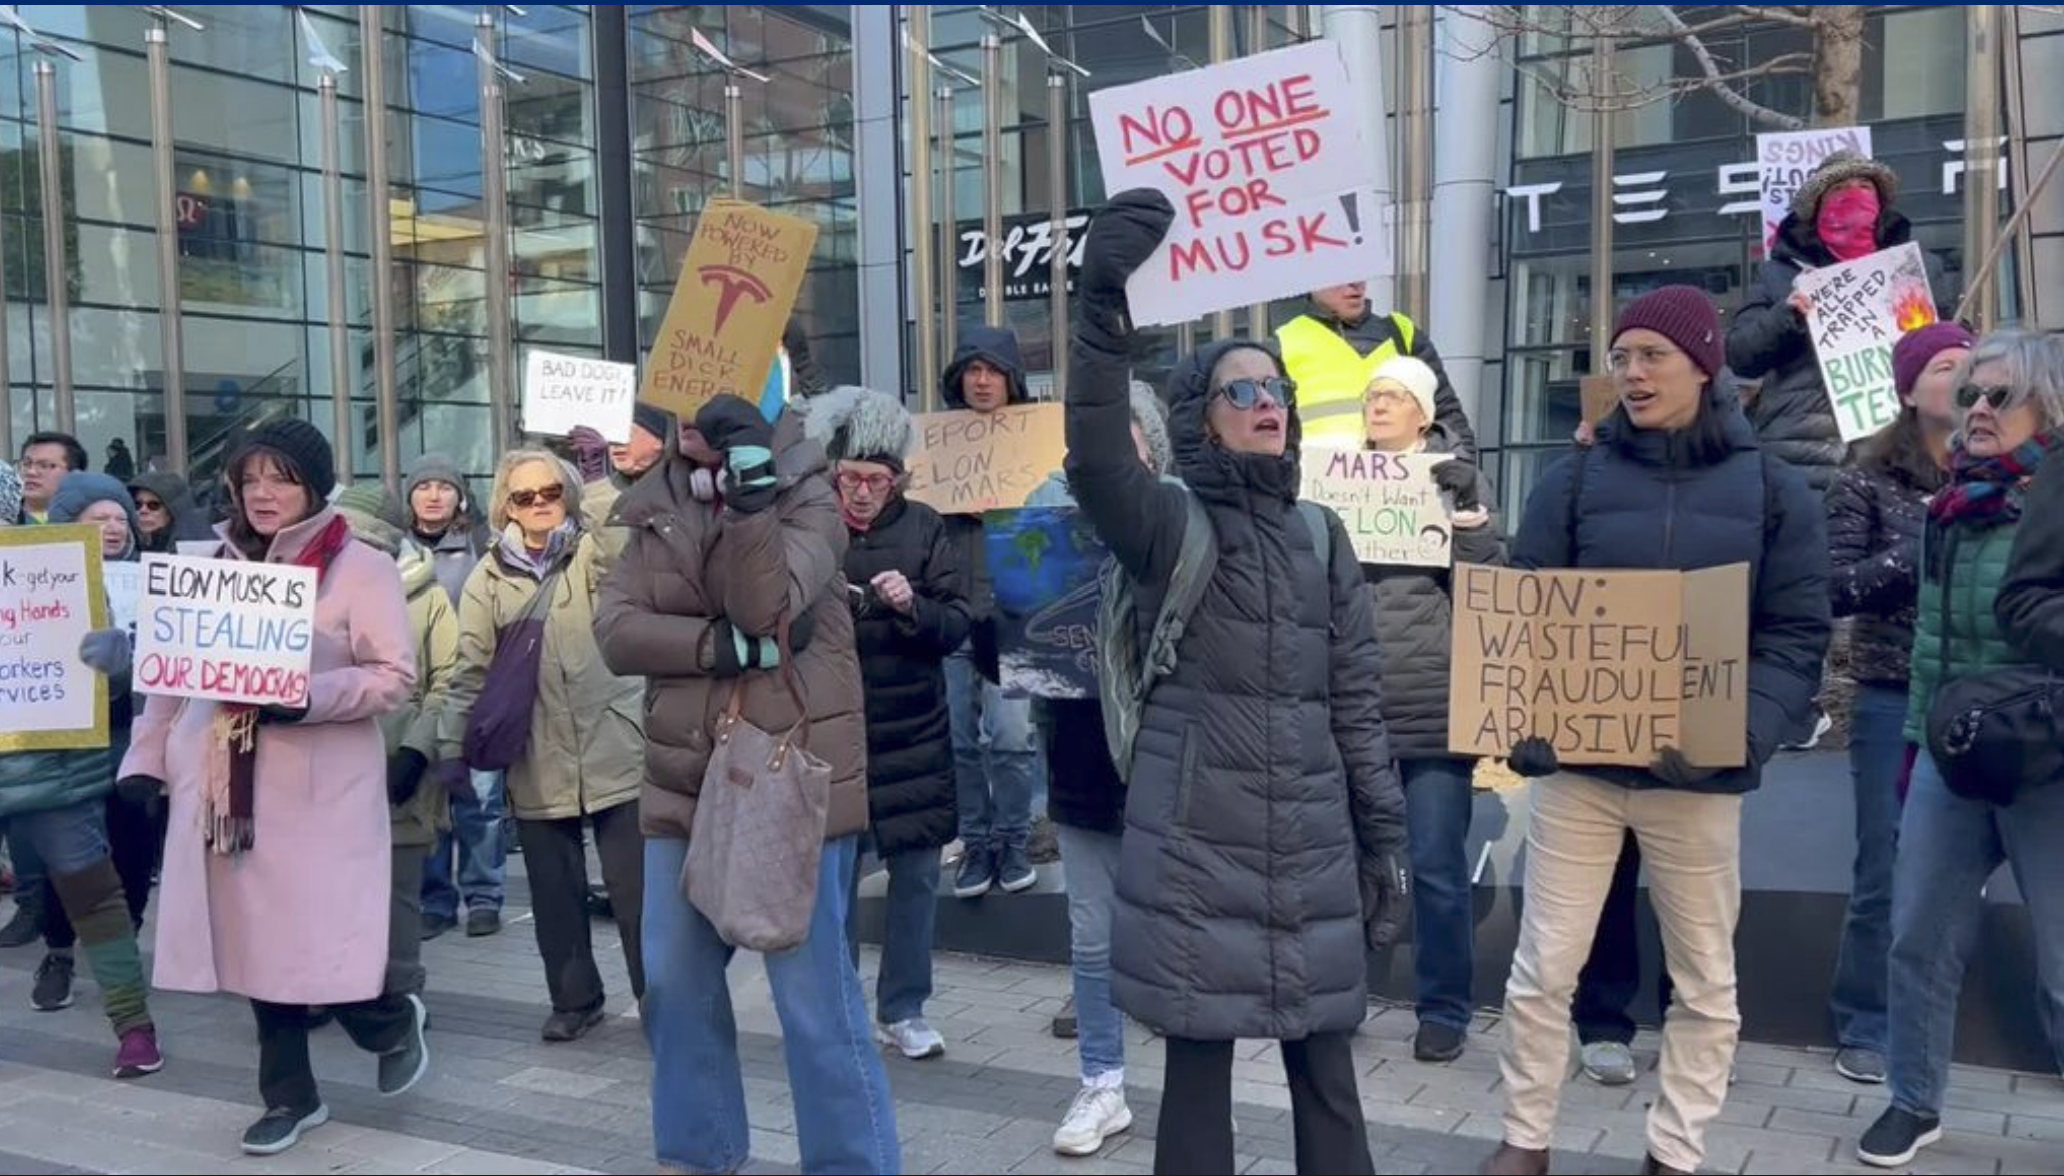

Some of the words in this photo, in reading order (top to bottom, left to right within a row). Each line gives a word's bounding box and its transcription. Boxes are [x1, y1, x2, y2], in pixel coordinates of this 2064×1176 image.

[1118, 106, 1193, 153] NO
[1214, 74, 1320, 128] ONE
[1163, 128, 1321, 186] VOTED
[1186, 178, 1287, 228] FOR
[701, 223, 789, 264] POWERED
[724, 212, 782, 241] NOW
[1169, 191, 1363, 281] MUSK!
[729, 250, 757, 267] BY
[979, 283, 1028, 298] DBLE
[1033, 280, 1074, 294] EAE
[1809, 268, 1857, 303] WE'RE
[1817, 293, 1851, 326] ALL
[1818, 269, 1886, 349] TRAPPED
[1853, 309, 1878, 333] IN
[670, 329, 739, 364] SMALL
[1871, 324, 1886, 341] A
[542, 360, 577, 378] BAD
[670, 352, 734, 379] DICK
[540, 381, 594, 403] LEAVE
[924, 409, 1038, 450] EPORT
[952, 463, 1037, 505] MARS
[1326, 452, 1410, 481] MARS
[1337, 507, 1416, 537] LON
[27, 566, 49, 593] get
[51, 572, 79, 591] your
[148, 562, 213, 599] ELON
[215, 569, 277, 604] MUSK
[284, 580, 307, 609] IS
[1467, 568, 1608, 618] ELON:
[20, 598, 71, 623] Hands
[154, 606, 309, 651] STEALING
[1477, 615, 1703, 662] WASTEFUL
[139, 653, 196, 691] OUR
[1479, 659, 1739, 704] FRAUDULENT
[1474, 706, 1677, 753] ABUSIVE
